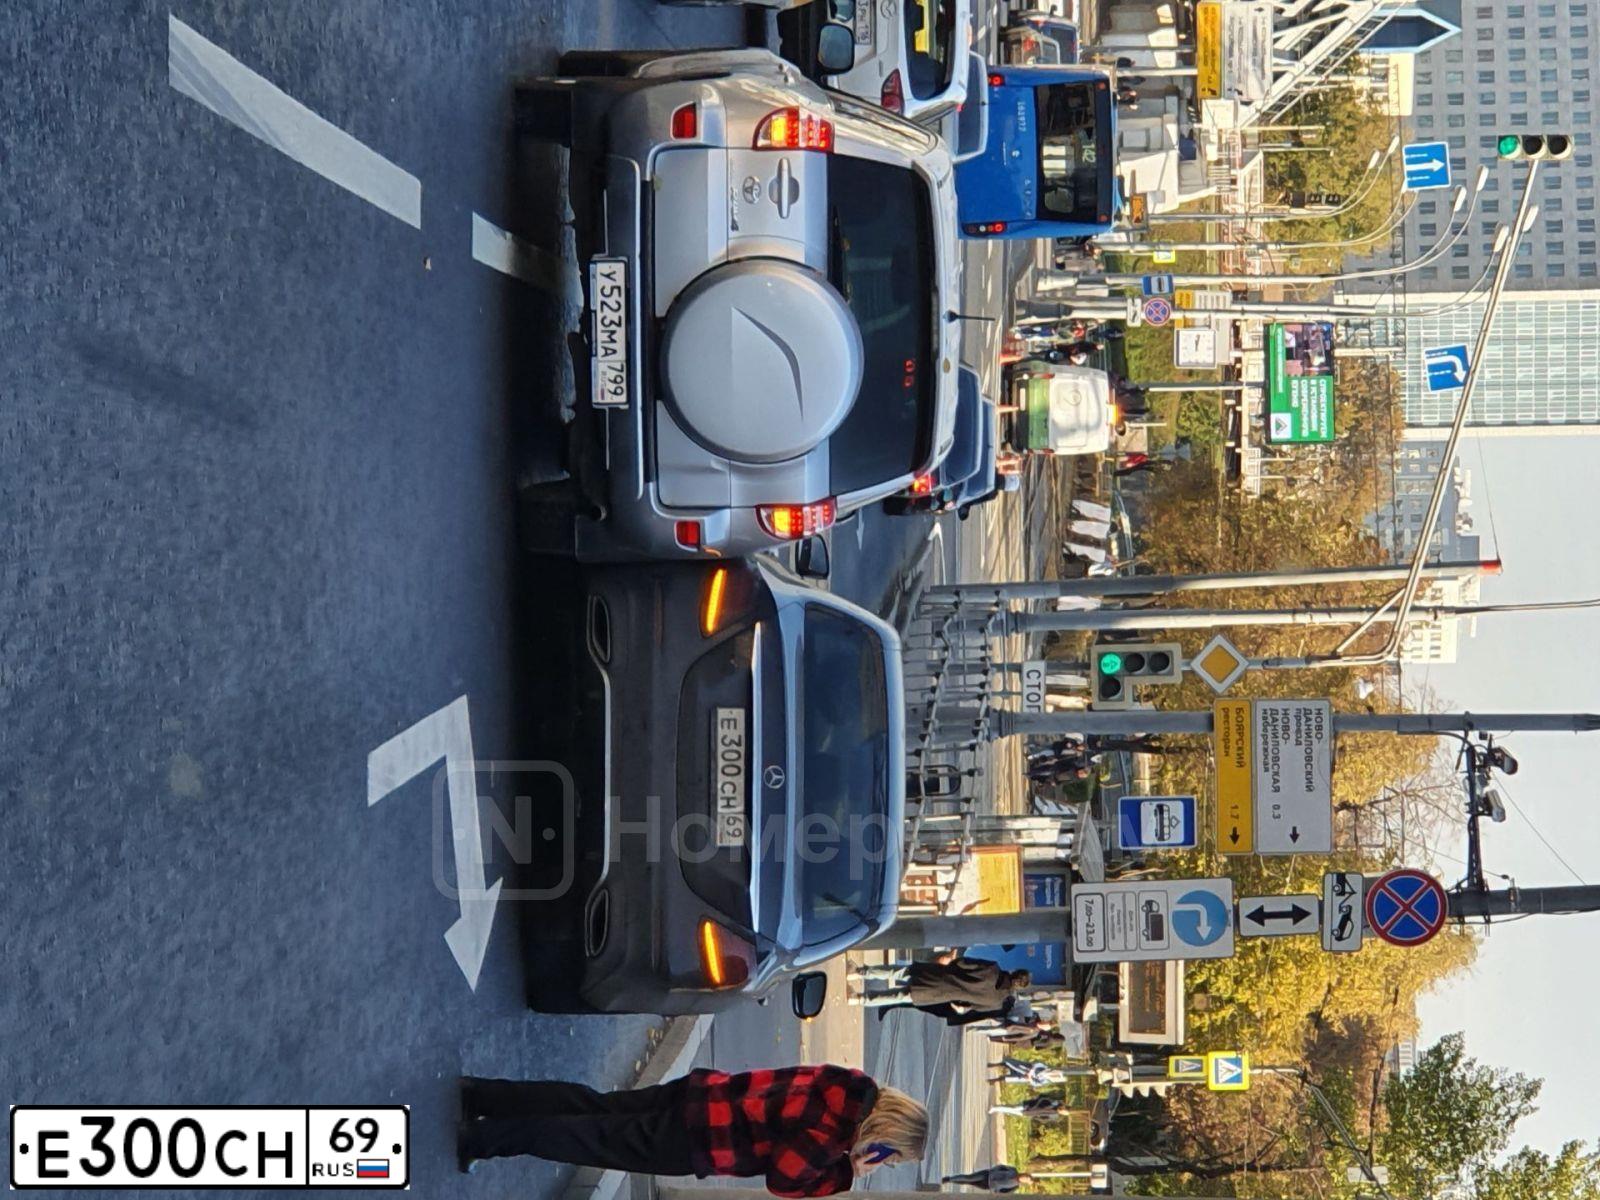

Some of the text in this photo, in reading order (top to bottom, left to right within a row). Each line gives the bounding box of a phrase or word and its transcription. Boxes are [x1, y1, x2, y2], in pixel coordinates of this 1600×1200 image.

[1082, 144, 1096, 163] 142
[600, 270, 624, 396] У523МА 799
[1222, 707, 1230, 757] ресторан
[1235, 707, 1245, 768] БОЯРСКИЙ
[1260, 708, 1270, 773] набережная
[1281, 708, 1290, 744] НОВО-
[1294, 708, 1302, 746] проезд
[1303, 708, 1315, 792] ДАНИЛОВСКИЙ
[1314, 708, 1323, 744] НОВО-
[720, 718, 742, 838] Е300СН 69
[1269, 708, 1280, 820] ДАНИЛОВСКАЯ 0.3
